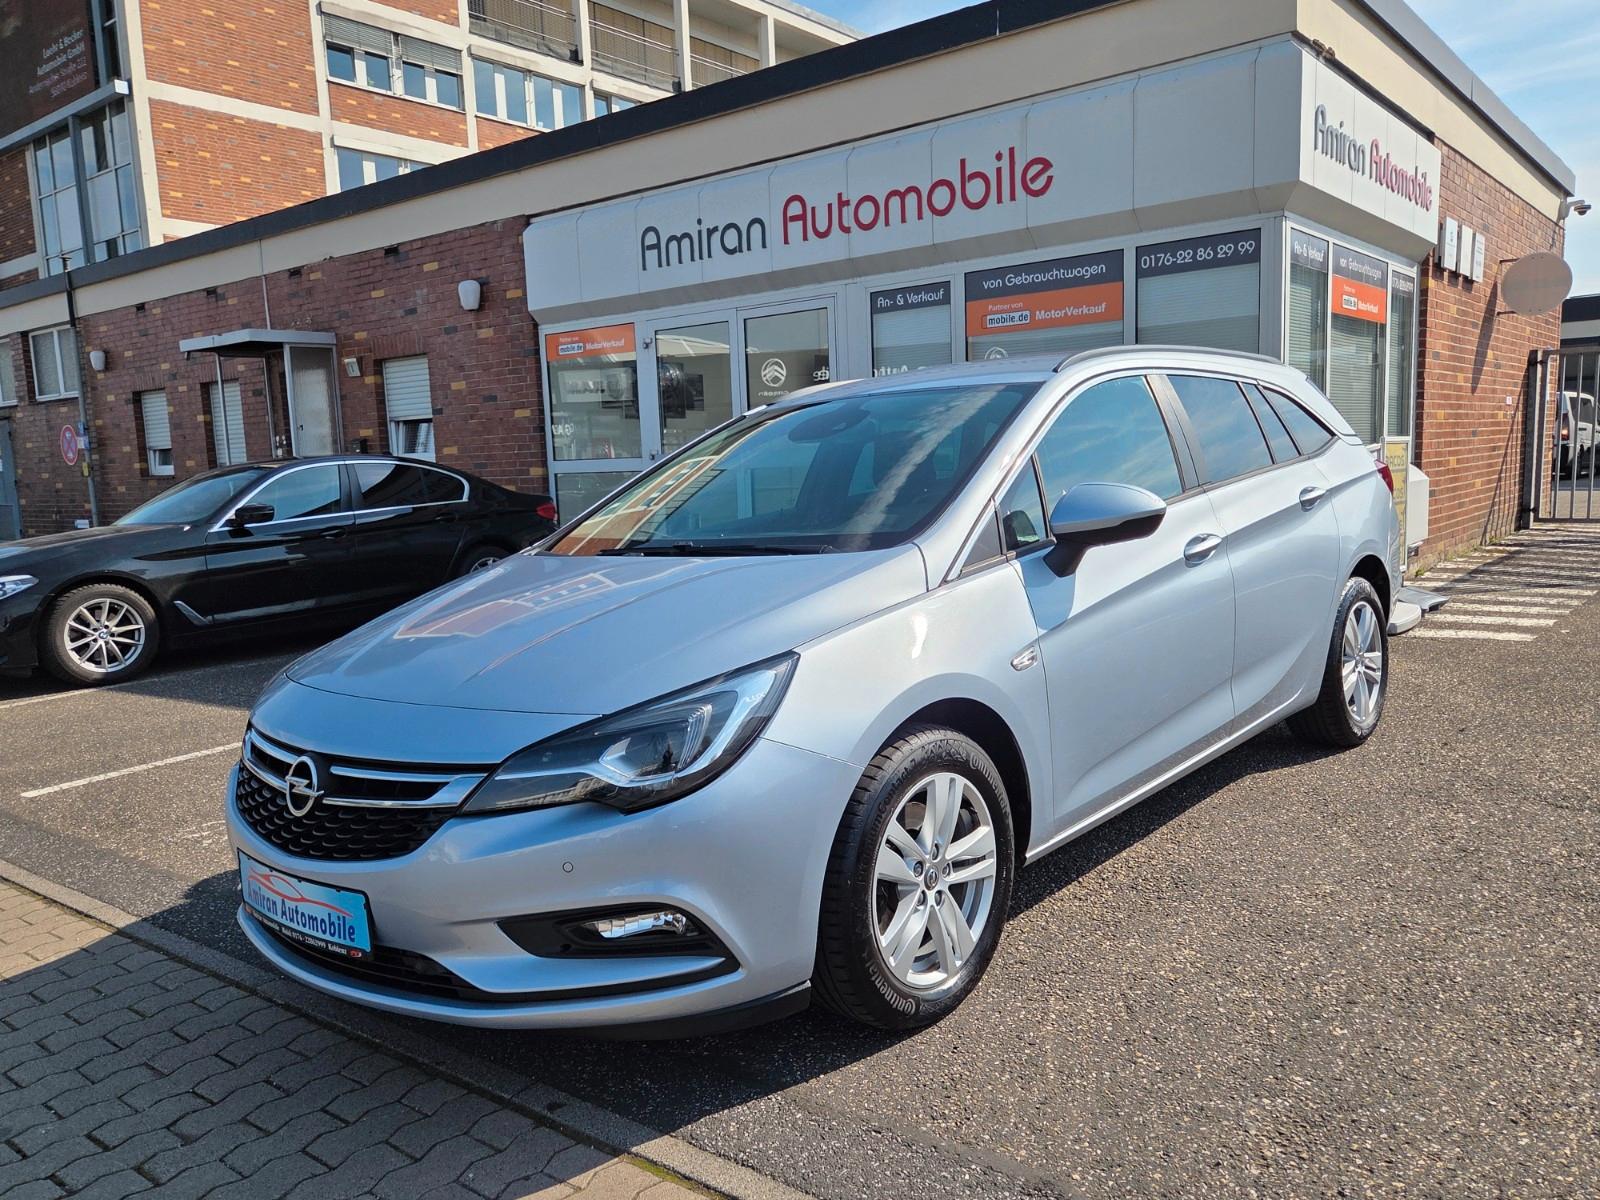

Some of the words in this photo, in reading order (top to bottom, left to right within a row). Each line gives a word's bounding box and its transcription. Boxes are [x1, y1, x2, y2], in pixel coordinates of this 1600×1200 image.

[1314, 104, 1366, 176] Amiran
[1369, 138, 1432, 212] Automobile
[641, 217, 767, 271] Amiran
[783, 146, 1054, 245] Automobile
[1141, 249, 1193, 269] 0176-22
[1197, 246, 1214, 261] 86
[1217, 243, 1234, 258] 29
[1238, 240, 1256, 256] 99
[983, 278, 1003, 290] von
[1005, 264, 1106, 287] Gebrauchtwagen
[877, 296, 894, 309] An-
[896, 294, 904, 306] &
[906, 288, 945, 304] Verkauf
[988, 303, 1010, 312] Partner
[1011, 302, 1023, 310] von
[1035, 302, 1107, 321] MotorVerkauf
[988, 311, 1029, 327] mobile.de
[281, 898, 356, 943] Automobile
[865, 960, 917, 1016] Continental
